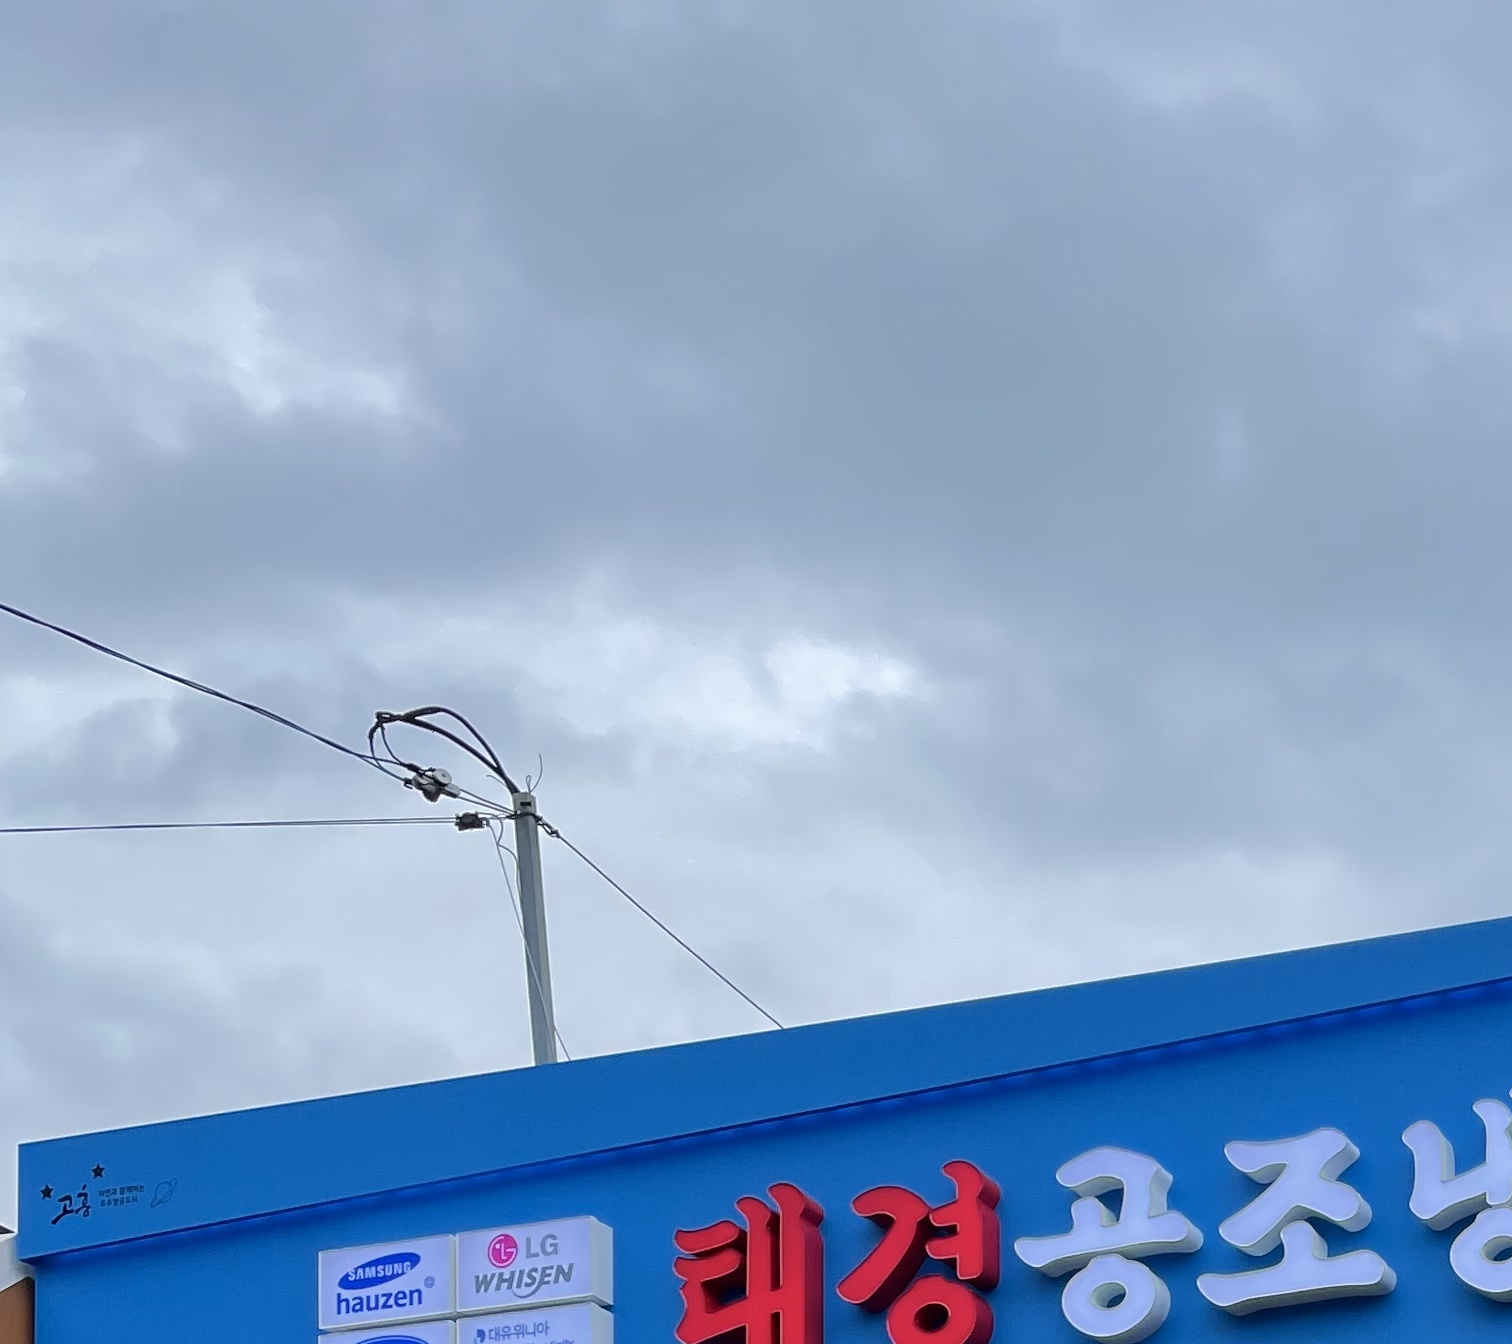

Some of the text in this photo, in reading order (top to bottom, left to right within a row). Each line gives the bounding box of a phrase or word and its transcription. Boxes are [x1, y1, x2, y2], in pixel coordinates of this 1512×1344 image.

[525, 1233, 559, 1260] LG
[347, 1261, 412, 1282] SAMSUNG
[474, 1262, 574, 1299] WHISEN
[336, 1287, 423, 1315] hauzen
[488, 1320, 551, 1343] 대유위니아
